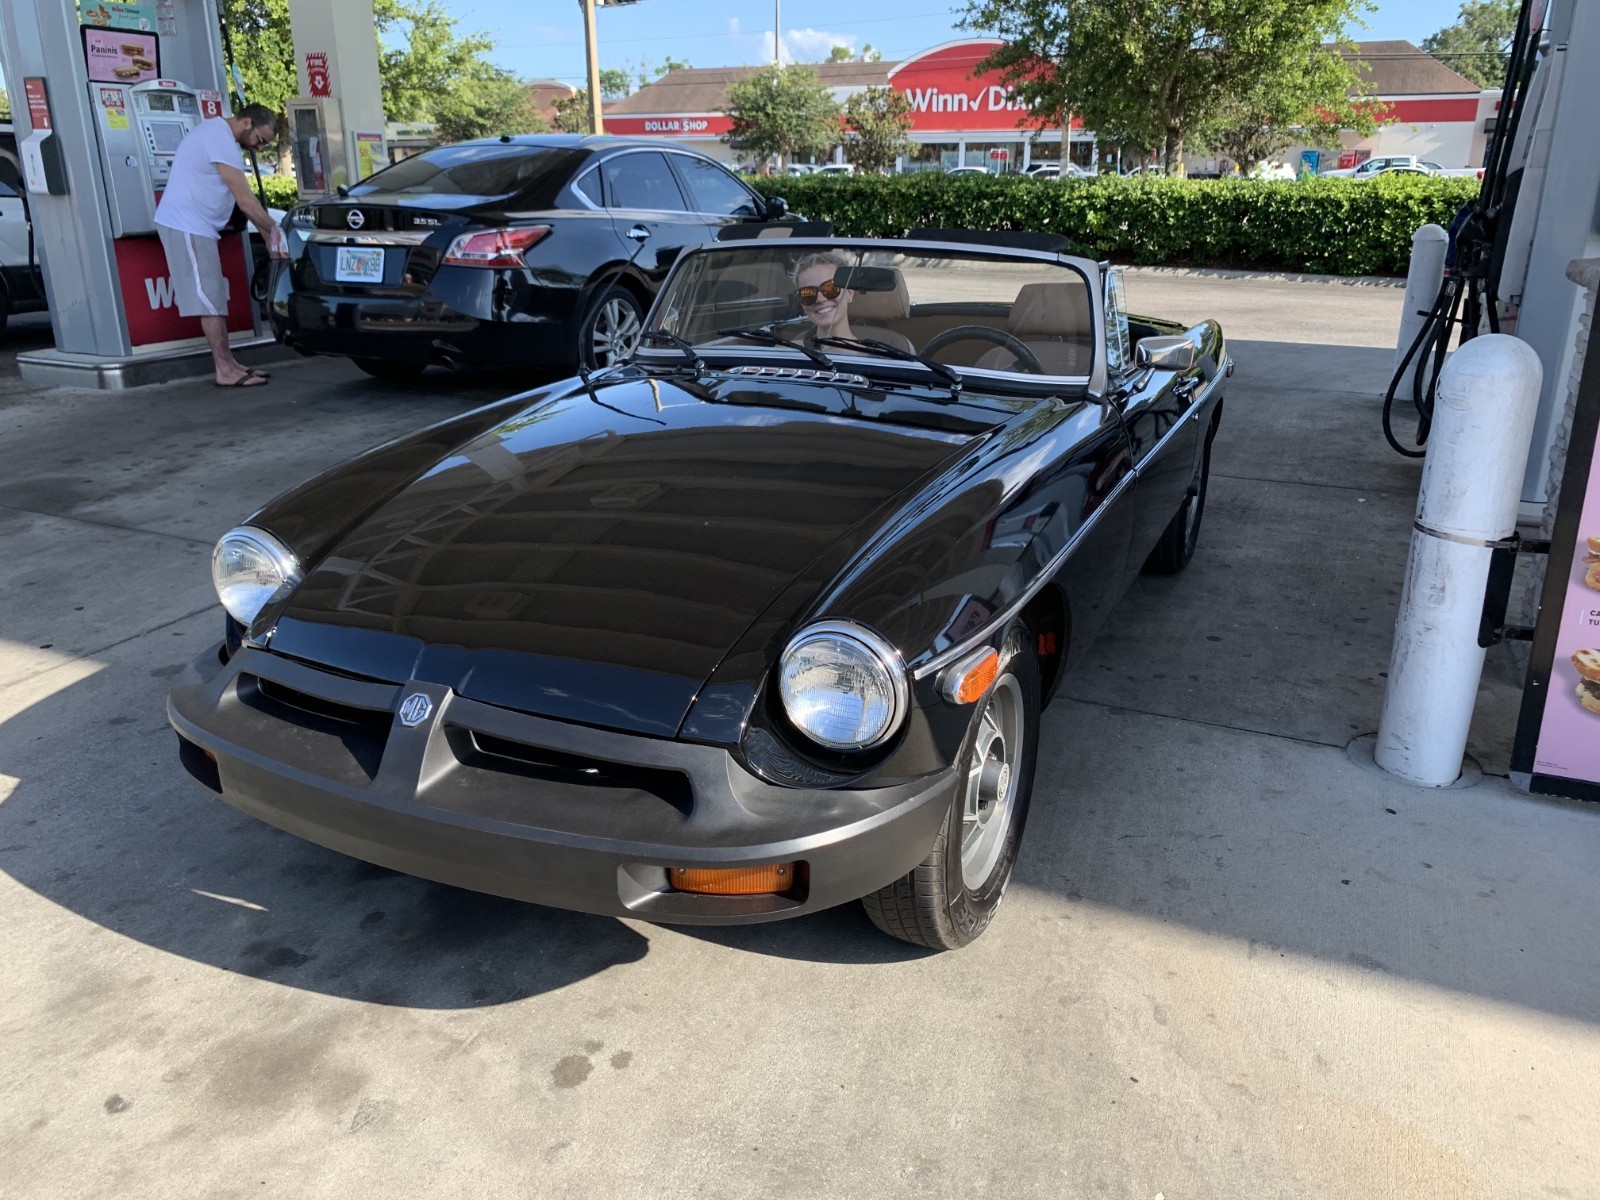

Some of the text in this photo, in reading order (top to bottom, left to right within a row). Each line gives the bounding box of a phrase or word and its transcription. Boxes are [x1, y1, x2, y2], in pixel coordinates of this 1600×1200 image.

[90, 44, 118, 55] Paninis
[905, 87, 968, 113] Winn
[207, 101, 217, 115] 8
[645, 121, 680, 131] DOLLAR
[401, 696, 428, 722] MG
